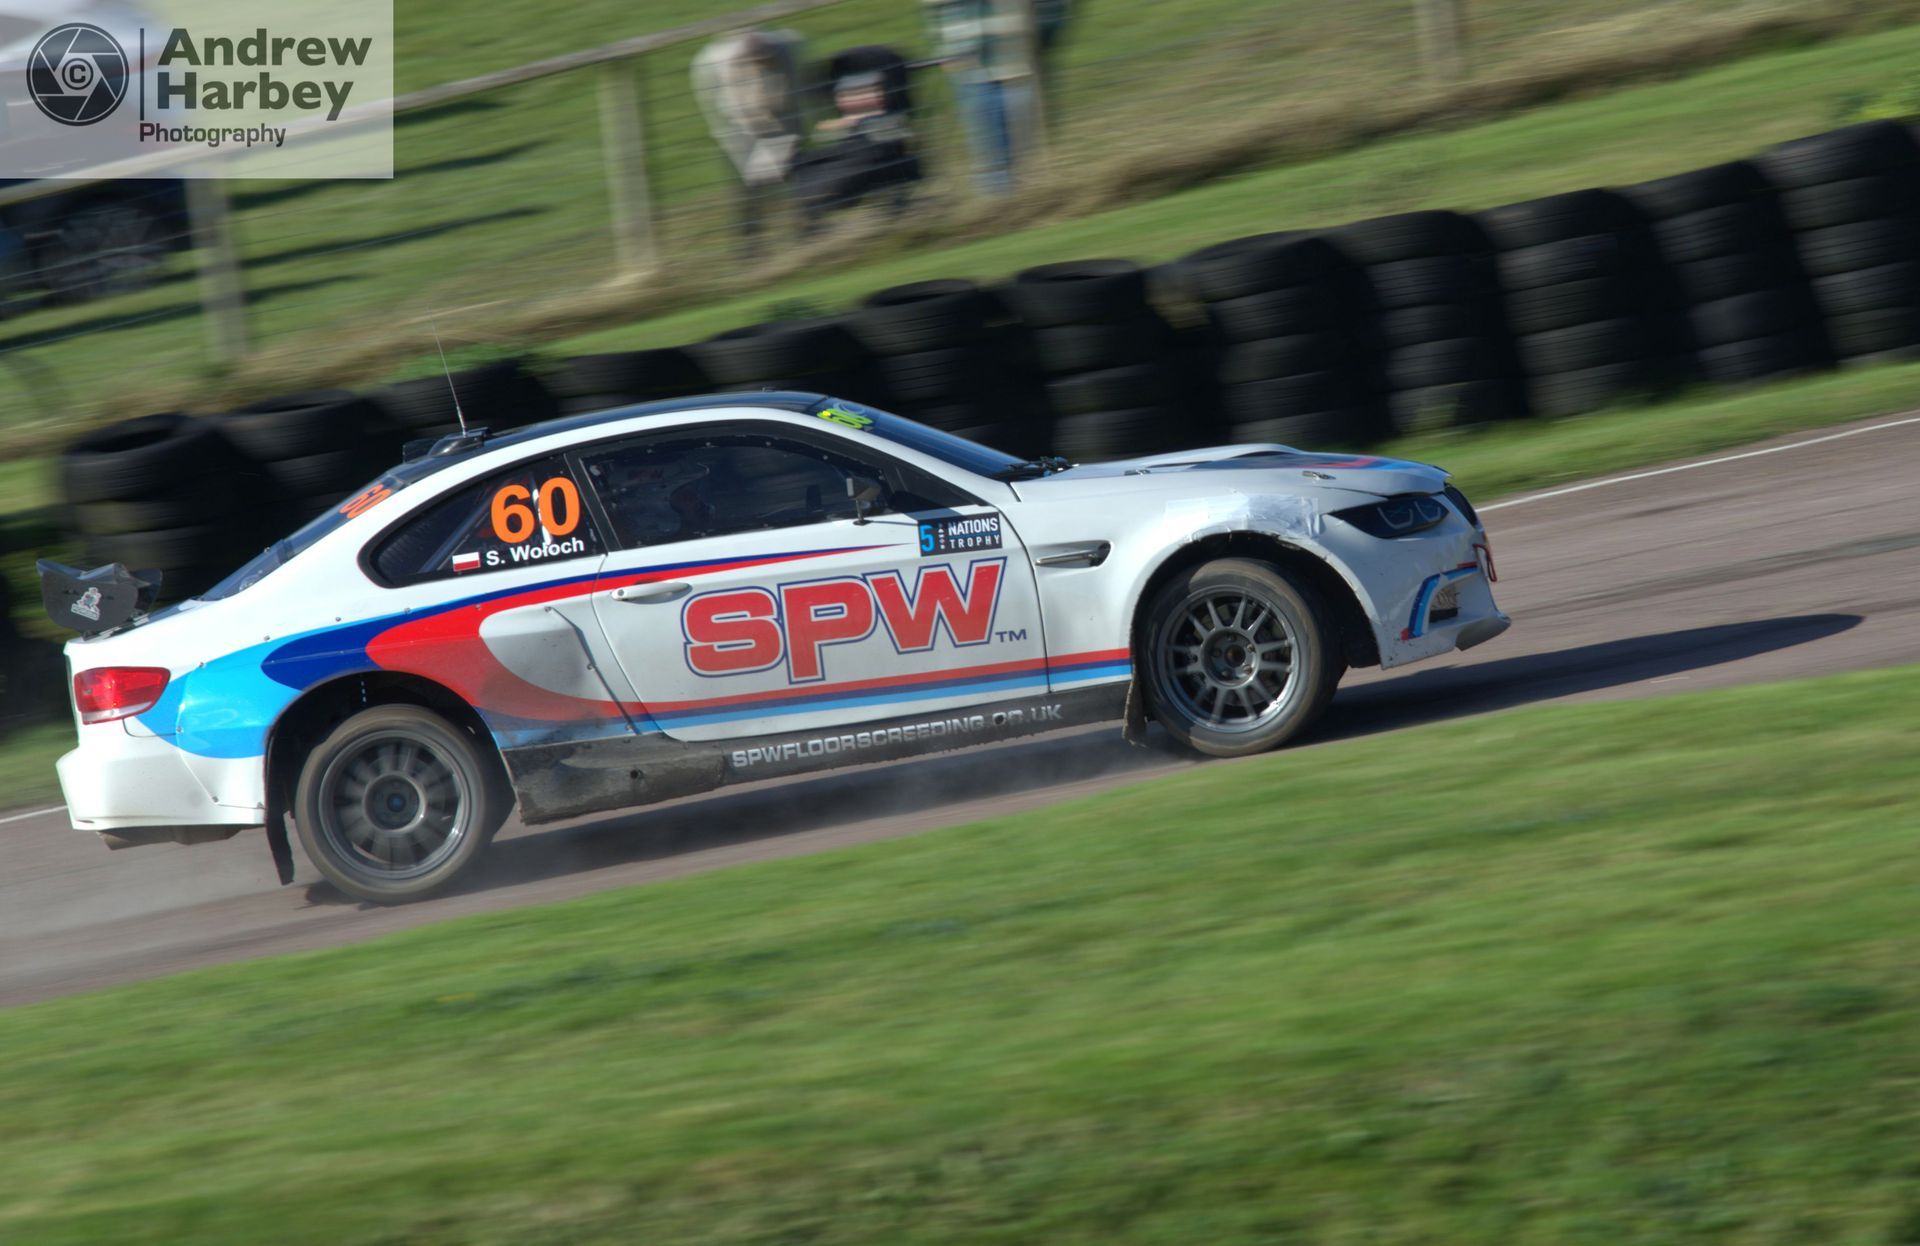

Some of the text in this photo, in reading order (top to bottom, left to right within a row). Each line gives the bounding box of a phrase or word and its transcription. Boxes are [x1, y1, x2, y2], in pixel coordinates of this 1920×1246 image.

[339, 483, 392, 519] 60
[491, 476, 580, 544] 60
[920, 524, 935, 553] 5
[947, 517, 999, 537] NATIONS
[949, 534, 1001, 549] TROPHY
[486, 550, 506, 566] S.
[680, 556, 1008, 685] SPW
